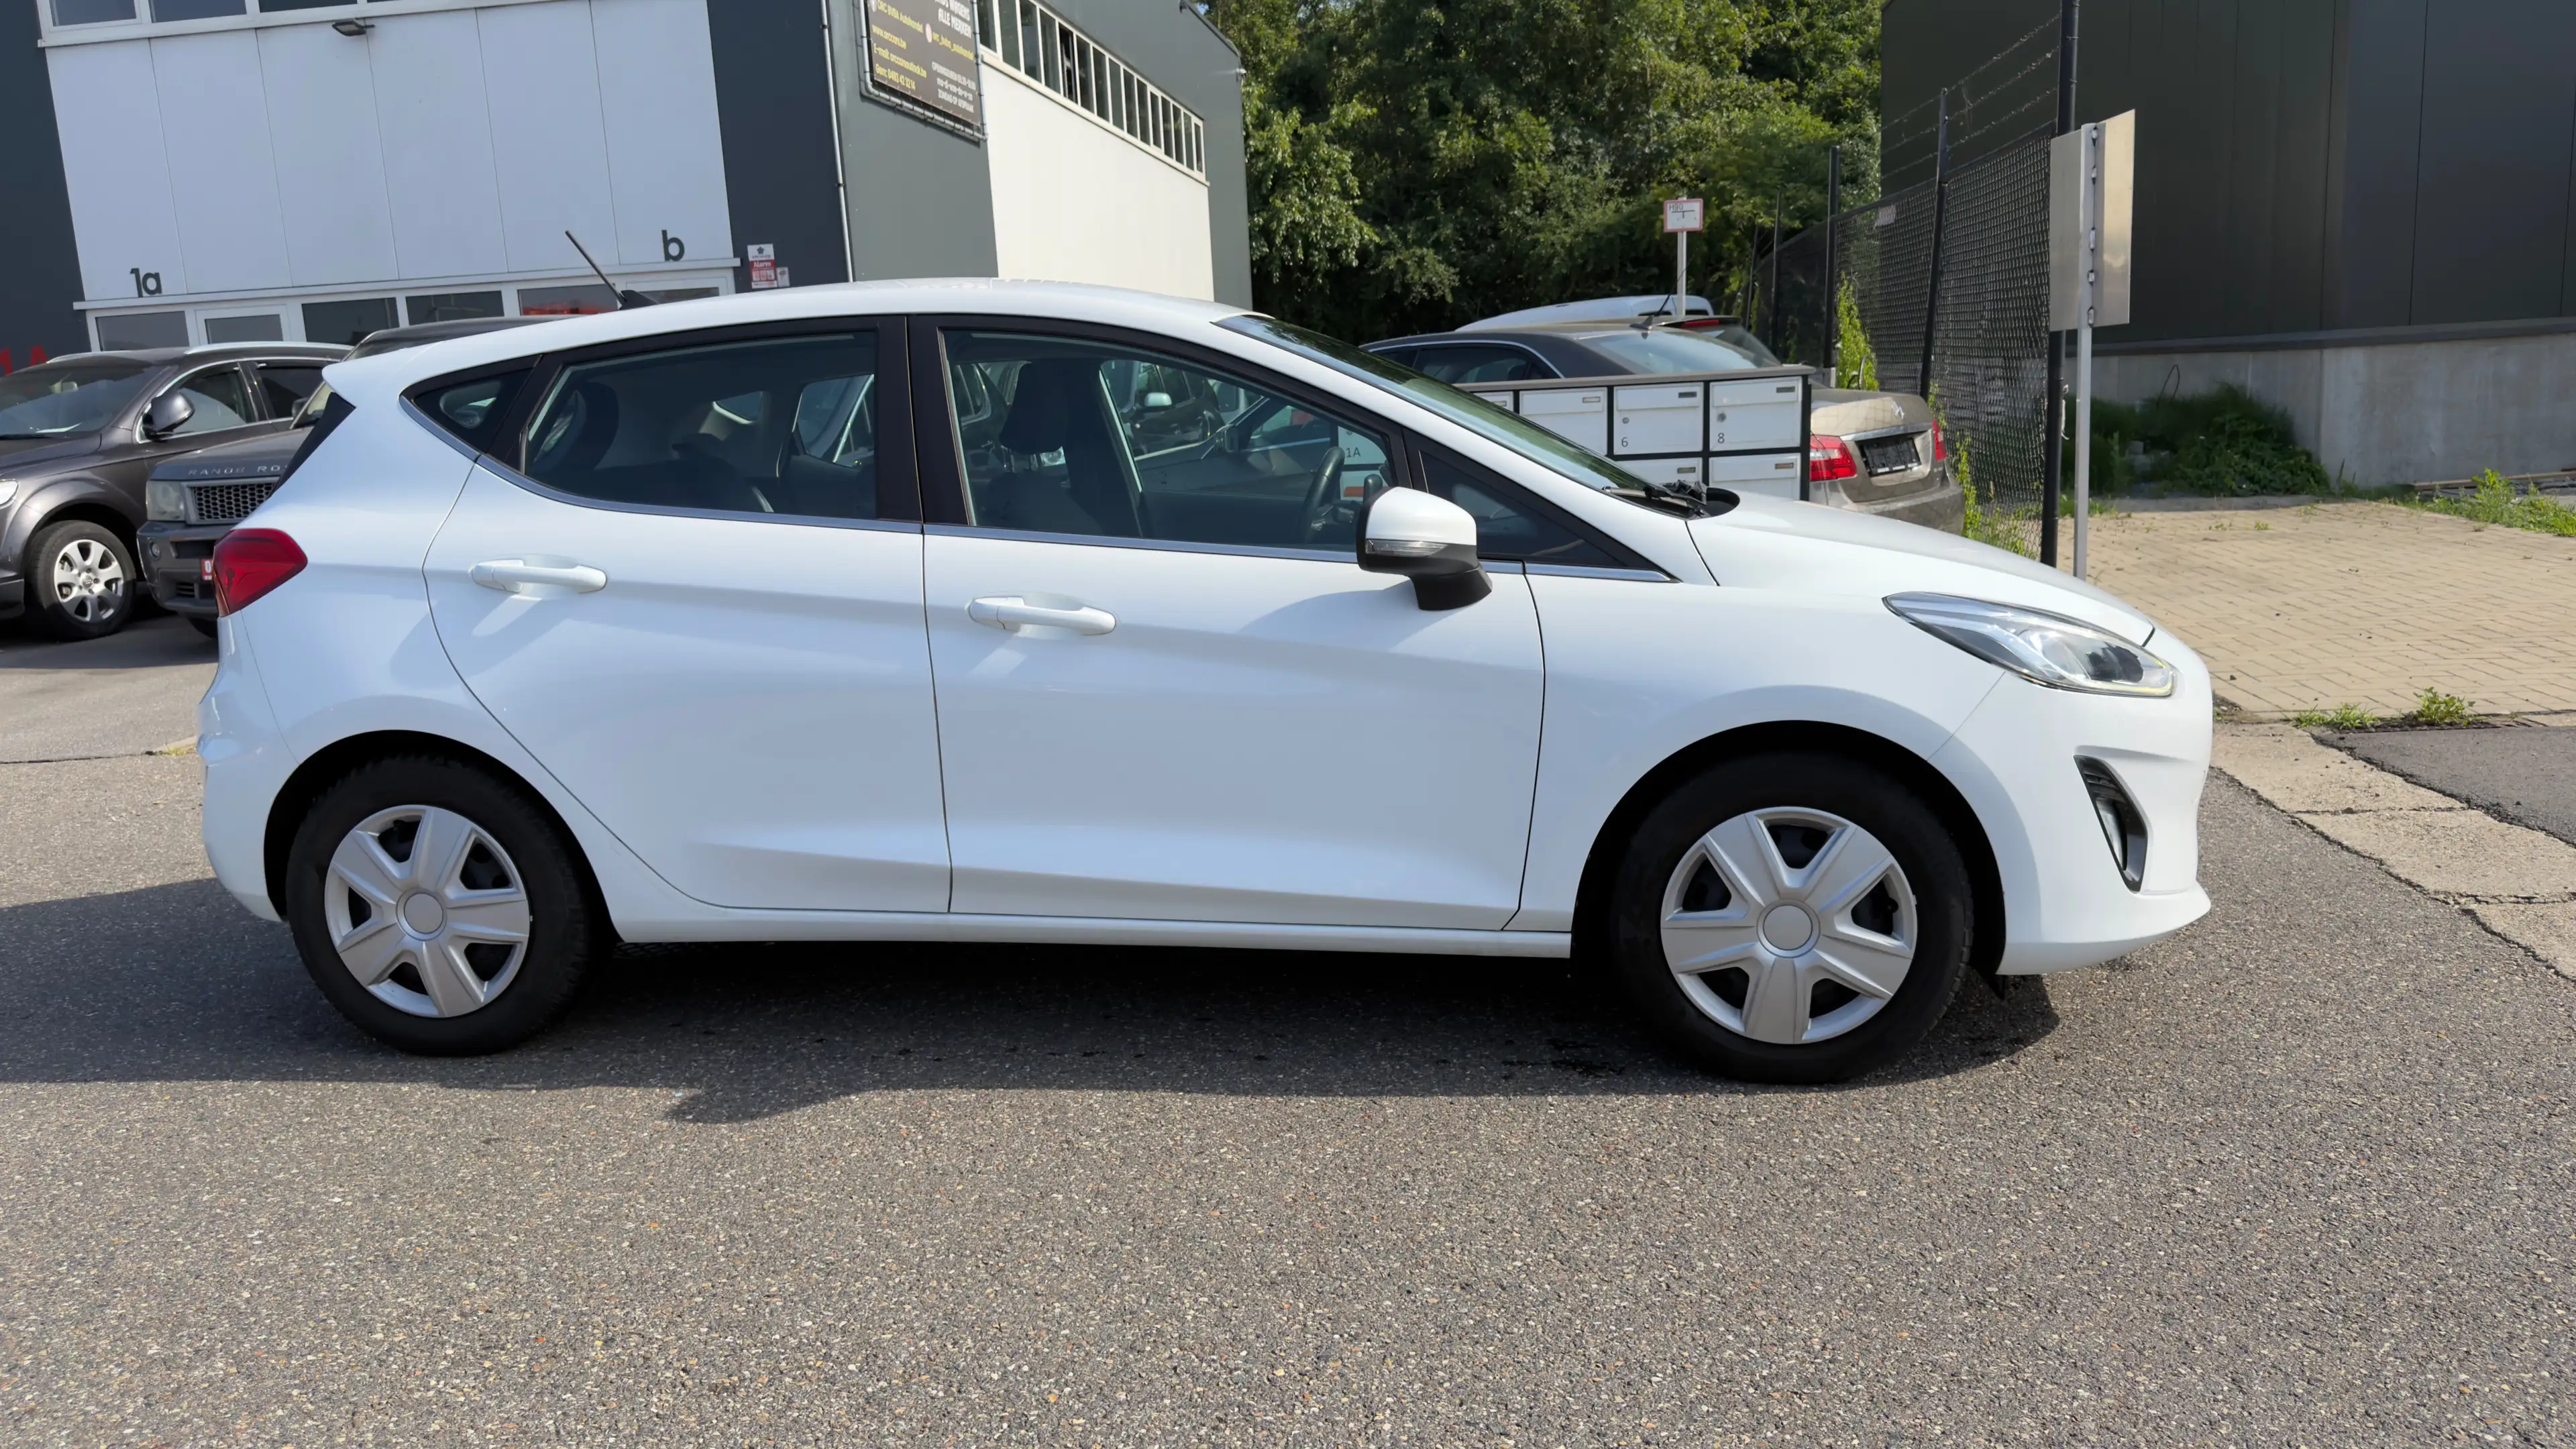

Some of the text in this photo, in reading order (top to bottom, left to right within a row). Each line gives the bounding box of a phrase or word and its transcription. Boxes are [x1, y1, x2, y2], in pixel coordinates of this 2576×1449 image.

[938, 7, 971, 39] ALLE MERKEN
[661, 229, 685, 262] b
[129, 268, 162, 298] 1a
[1621, 436, 1629, 447] 6
[1717, 432, 1725, 443] 8
[1345, 447, 1361, 458] 1A
